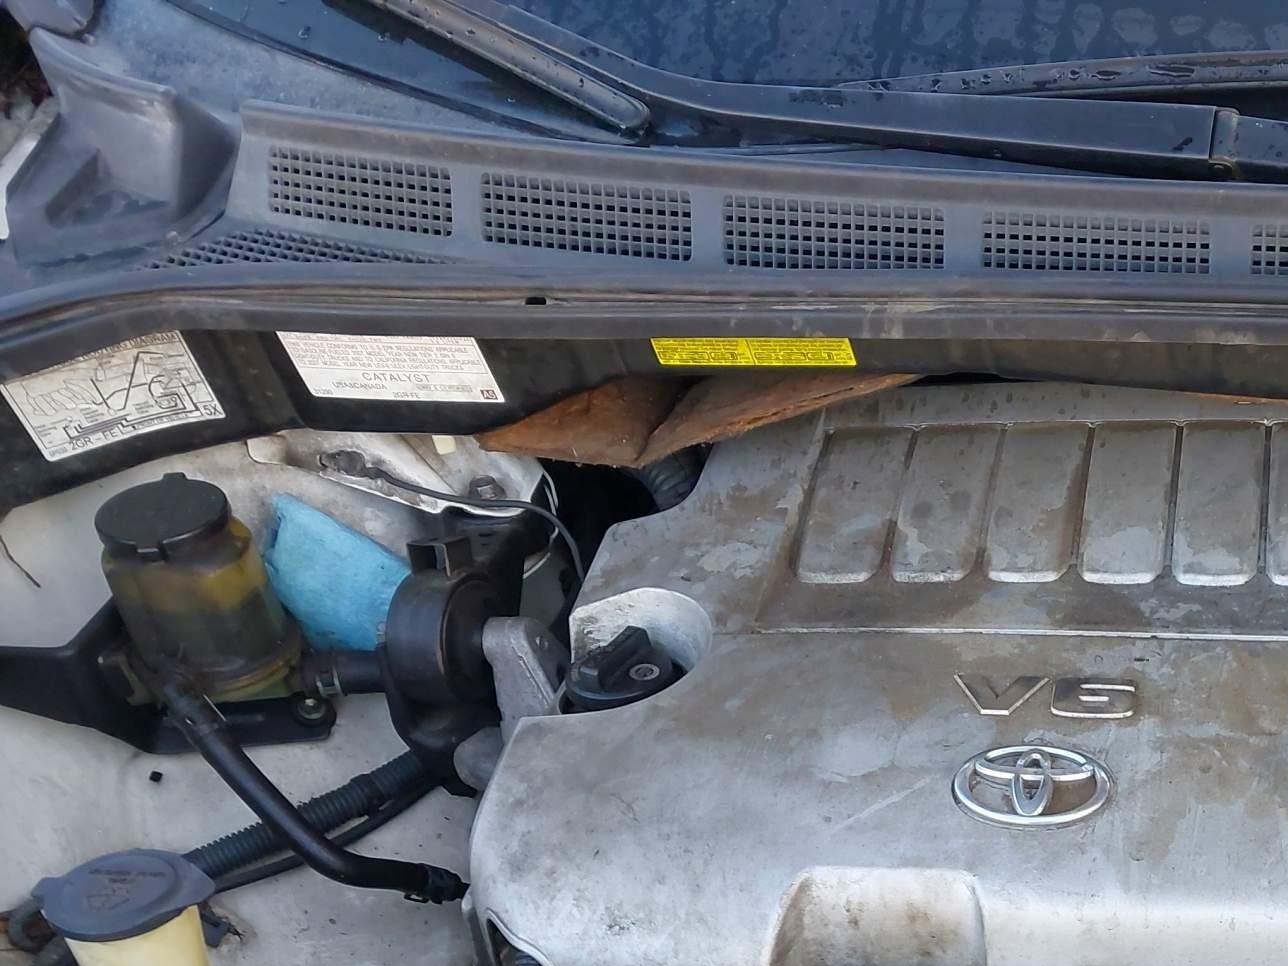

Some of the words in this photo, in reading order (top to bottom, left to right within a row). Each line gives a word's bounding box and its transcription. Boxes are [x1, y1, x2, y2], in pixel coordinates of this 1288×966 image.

[361, 372, 431, 384] CATALYST
[202, 404, 224, 417] 5X
[954, 674, 1138, 719] V6
